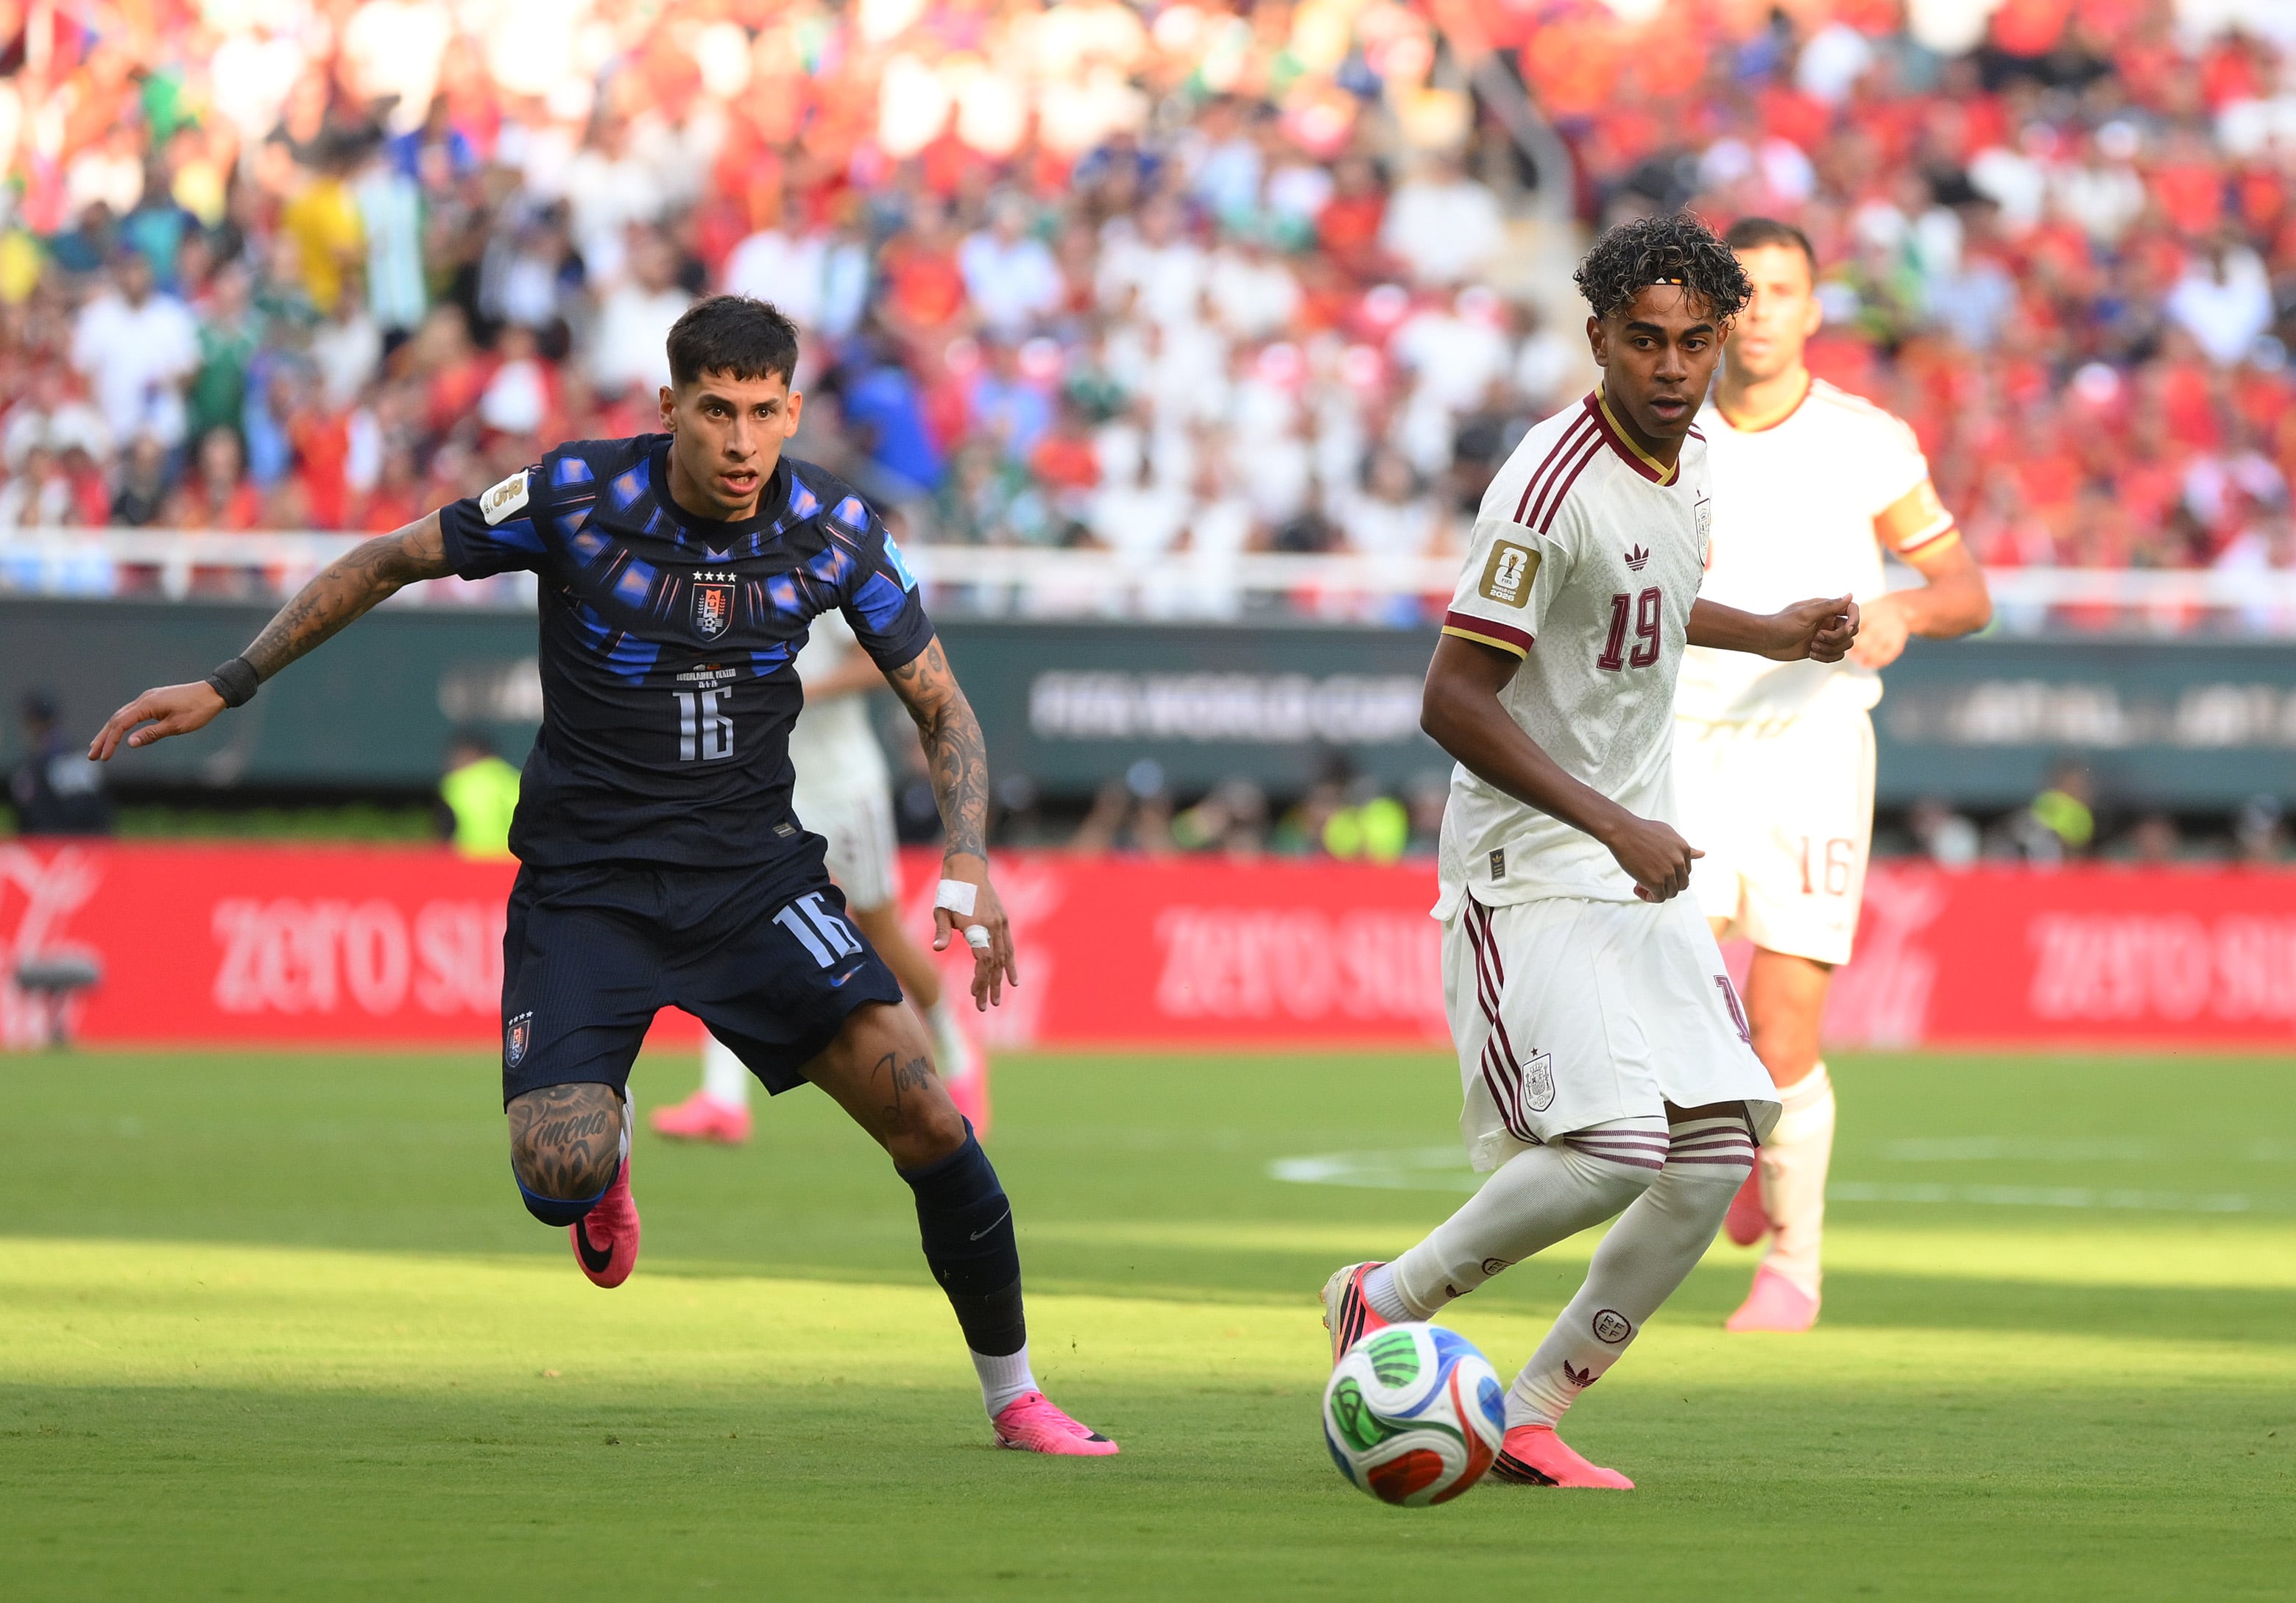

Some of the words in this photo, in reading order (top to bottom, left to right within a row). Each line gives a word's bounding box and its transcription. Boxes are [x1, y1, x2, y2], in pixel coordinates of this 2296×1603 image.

[707, 594, 717, 615] AUF
[1489, 589, 1515, 601] 2026
[1492, 584, 1508, 592] WORLD
[1596, 586, 1661, 672] 19
[673, 686, 733, 761] 16
[1141, 671, 1310, 740] WORLD
[1801, 835, 1854, 896] 16
[211, 898, 411, 1016] zero
[414, 898, 506, 1016] su
[771, 891, 863, 969] 16
[1153, 904, 1331, 1019] zero
[2026, 911, 2208, 1022] zero
[515, 1102, 606, 1148] Ximena
